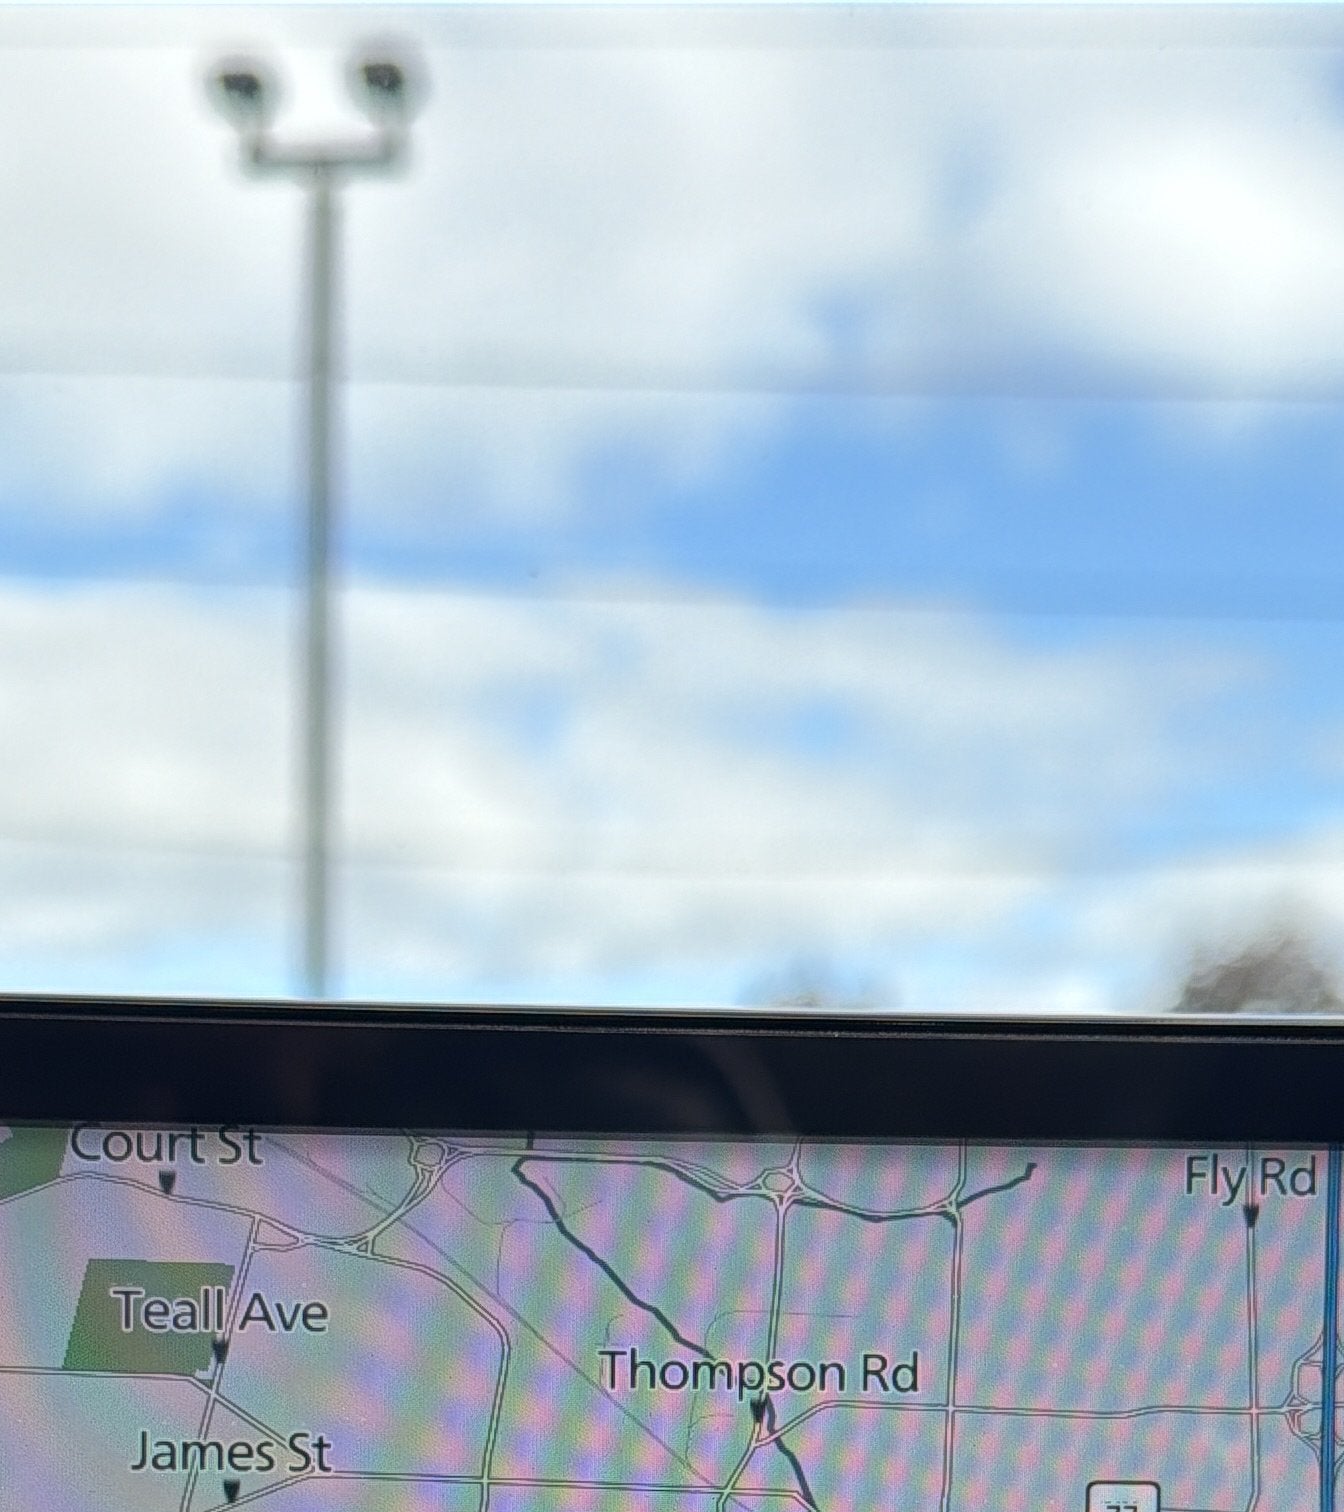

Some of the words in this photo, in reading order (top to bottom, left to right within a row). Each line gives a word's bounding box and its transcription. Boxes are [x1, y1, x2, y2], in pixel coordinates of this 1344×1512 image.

[70, 1124, 204, 1163] Court
[218, 1126, 263, 1164] St
[1185, 1156, 1246, 1204] Fly
[1259, 1156, 1316, 1197] Rd
[112, 1289, 224, 1331] Teall
[238, 1292, 329, 1333] Ave
[600, 1348, 845, 1401] Thompson
[862, 1351, 919, 1393] Rd
[131, 1432, 274, 1473] James
[287, 1433, 332, 1473] St
